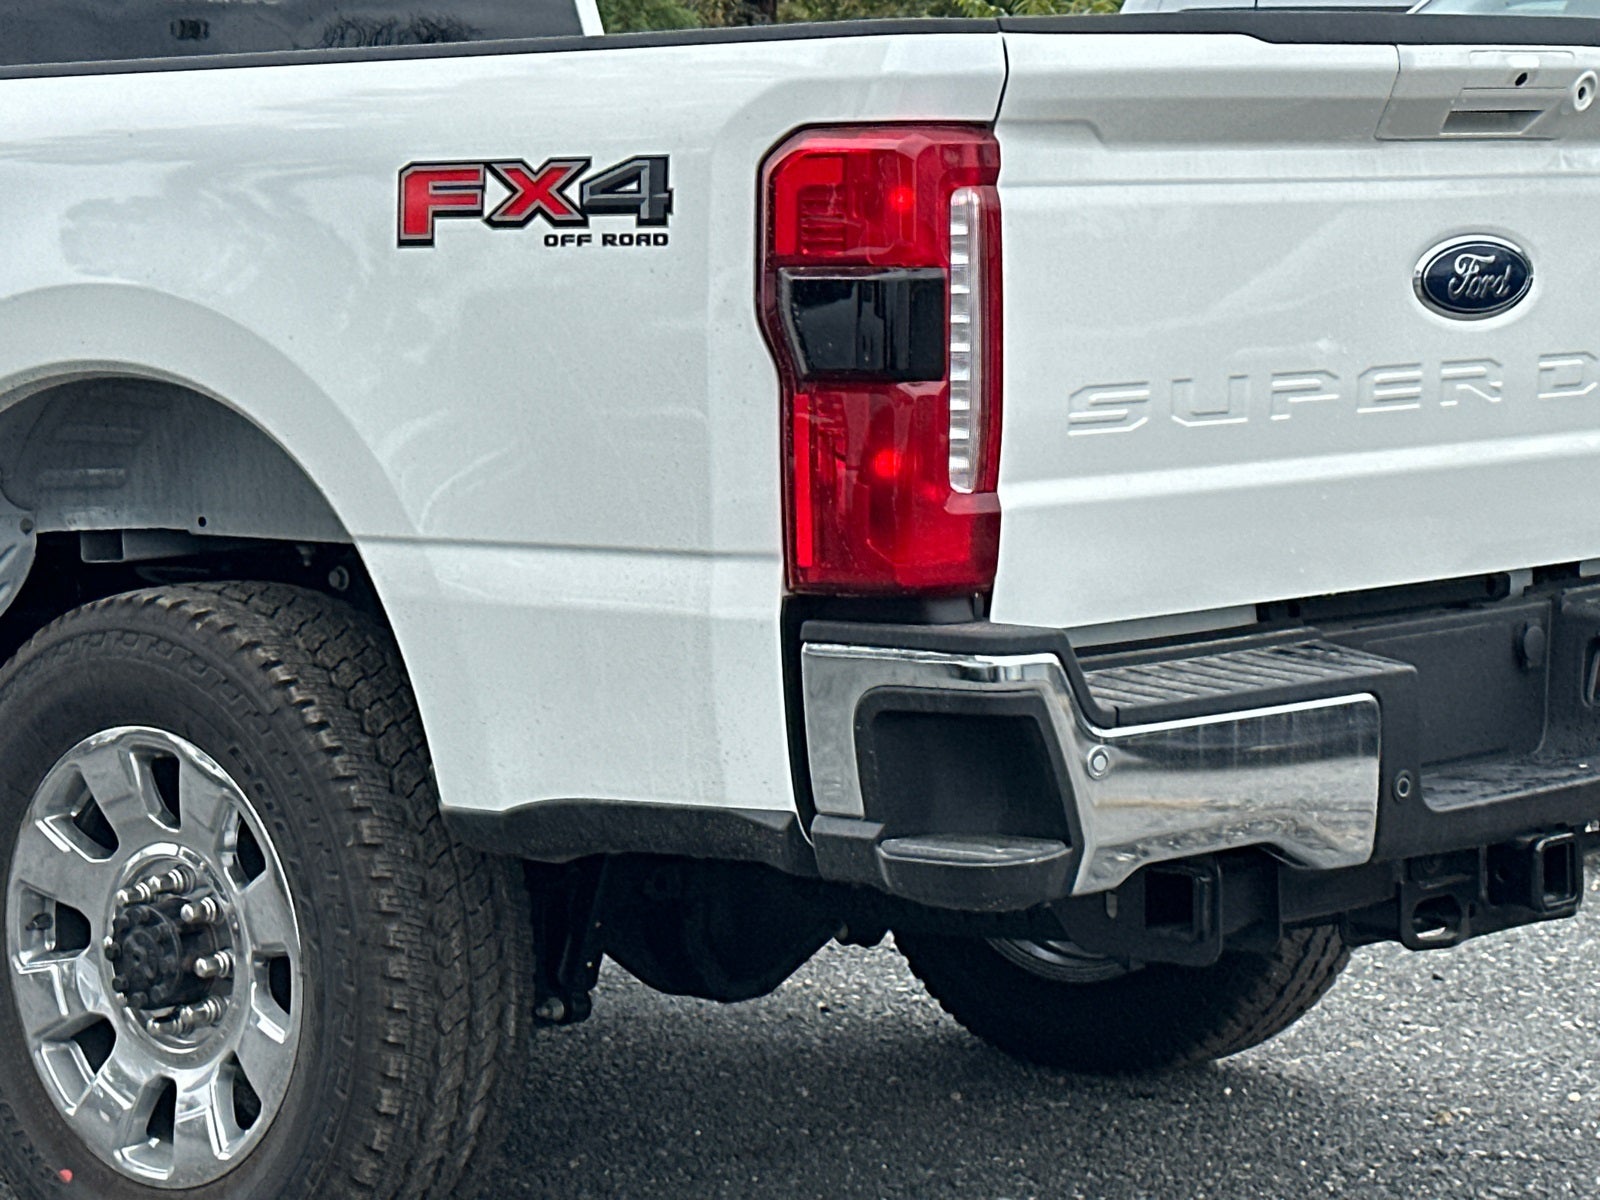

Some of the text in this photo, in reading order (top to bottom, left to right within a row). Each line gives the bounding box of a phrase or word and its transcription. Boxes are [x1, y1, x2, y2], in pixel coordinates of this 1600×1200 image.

[397, 154, 673, 248] FX4
[543, 233, 669, 247] OFF ROAD
[1448, 253, 1511, 299] Ford
[1068, 358, 1503, 436] SUPER
